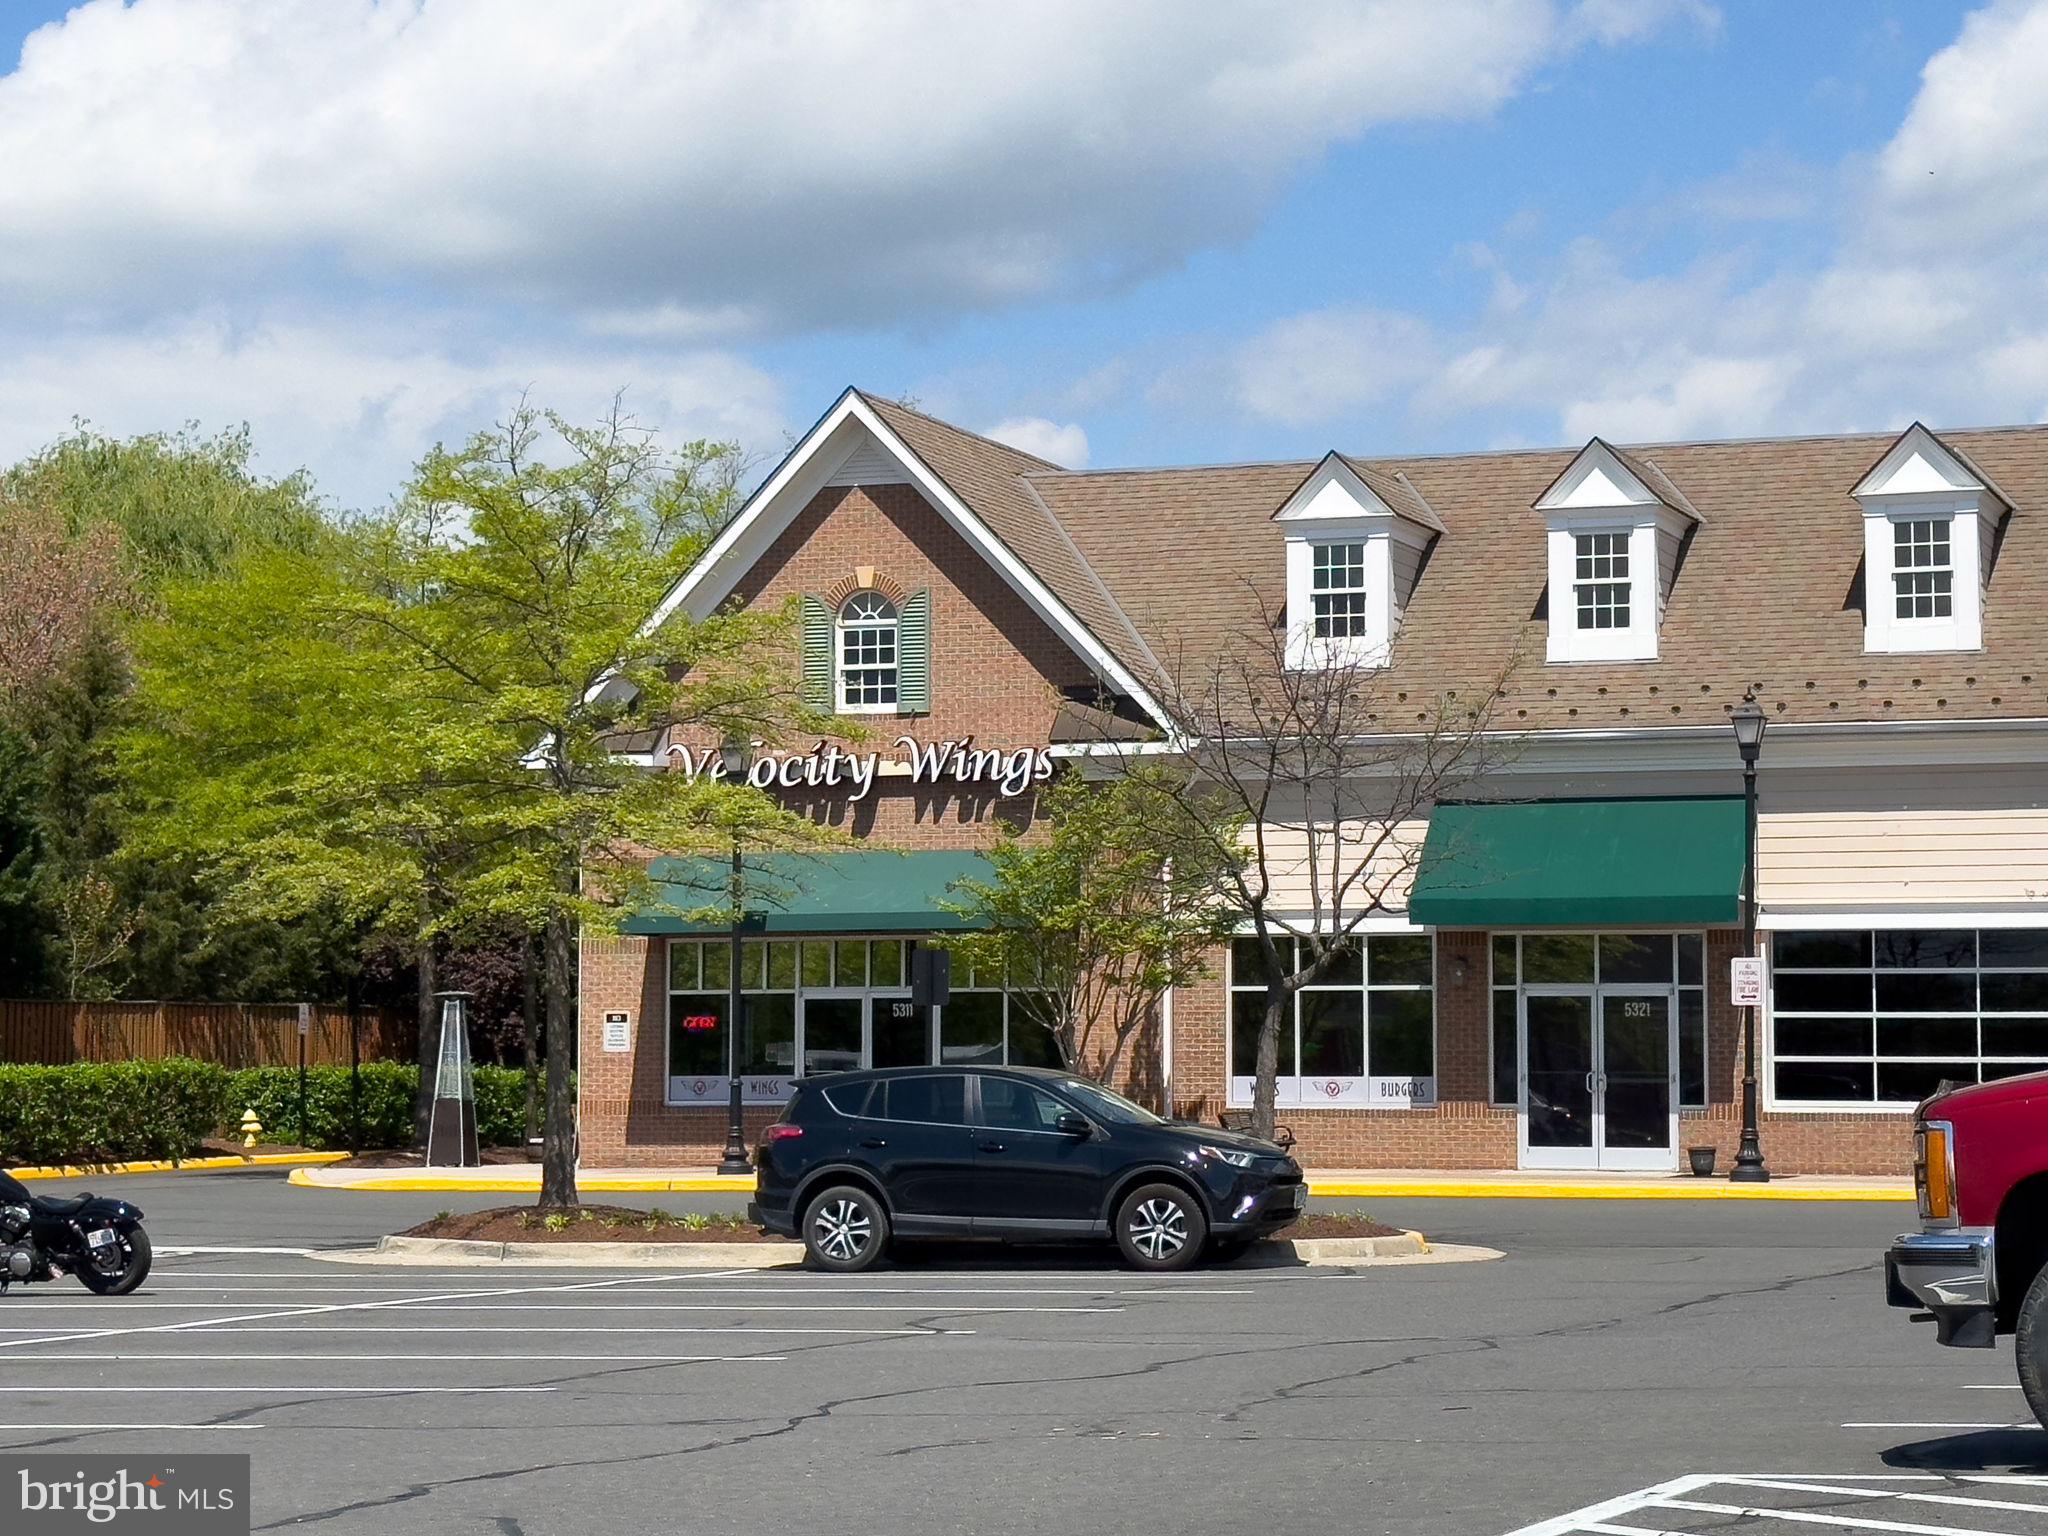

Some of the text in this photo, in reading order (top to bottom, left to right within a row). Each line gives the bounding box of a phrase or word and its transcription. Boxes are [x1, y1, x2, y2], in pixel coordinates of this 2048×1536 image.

[893, 734, 1053, 797] Wings
[892, 1003, 913, 1018] 5311
[1624, 1002, 1650, 1017] 5321
[750, 1080, 779, 1095] WINGS
[1381, 1082, 1425, 1097] BURGERS
